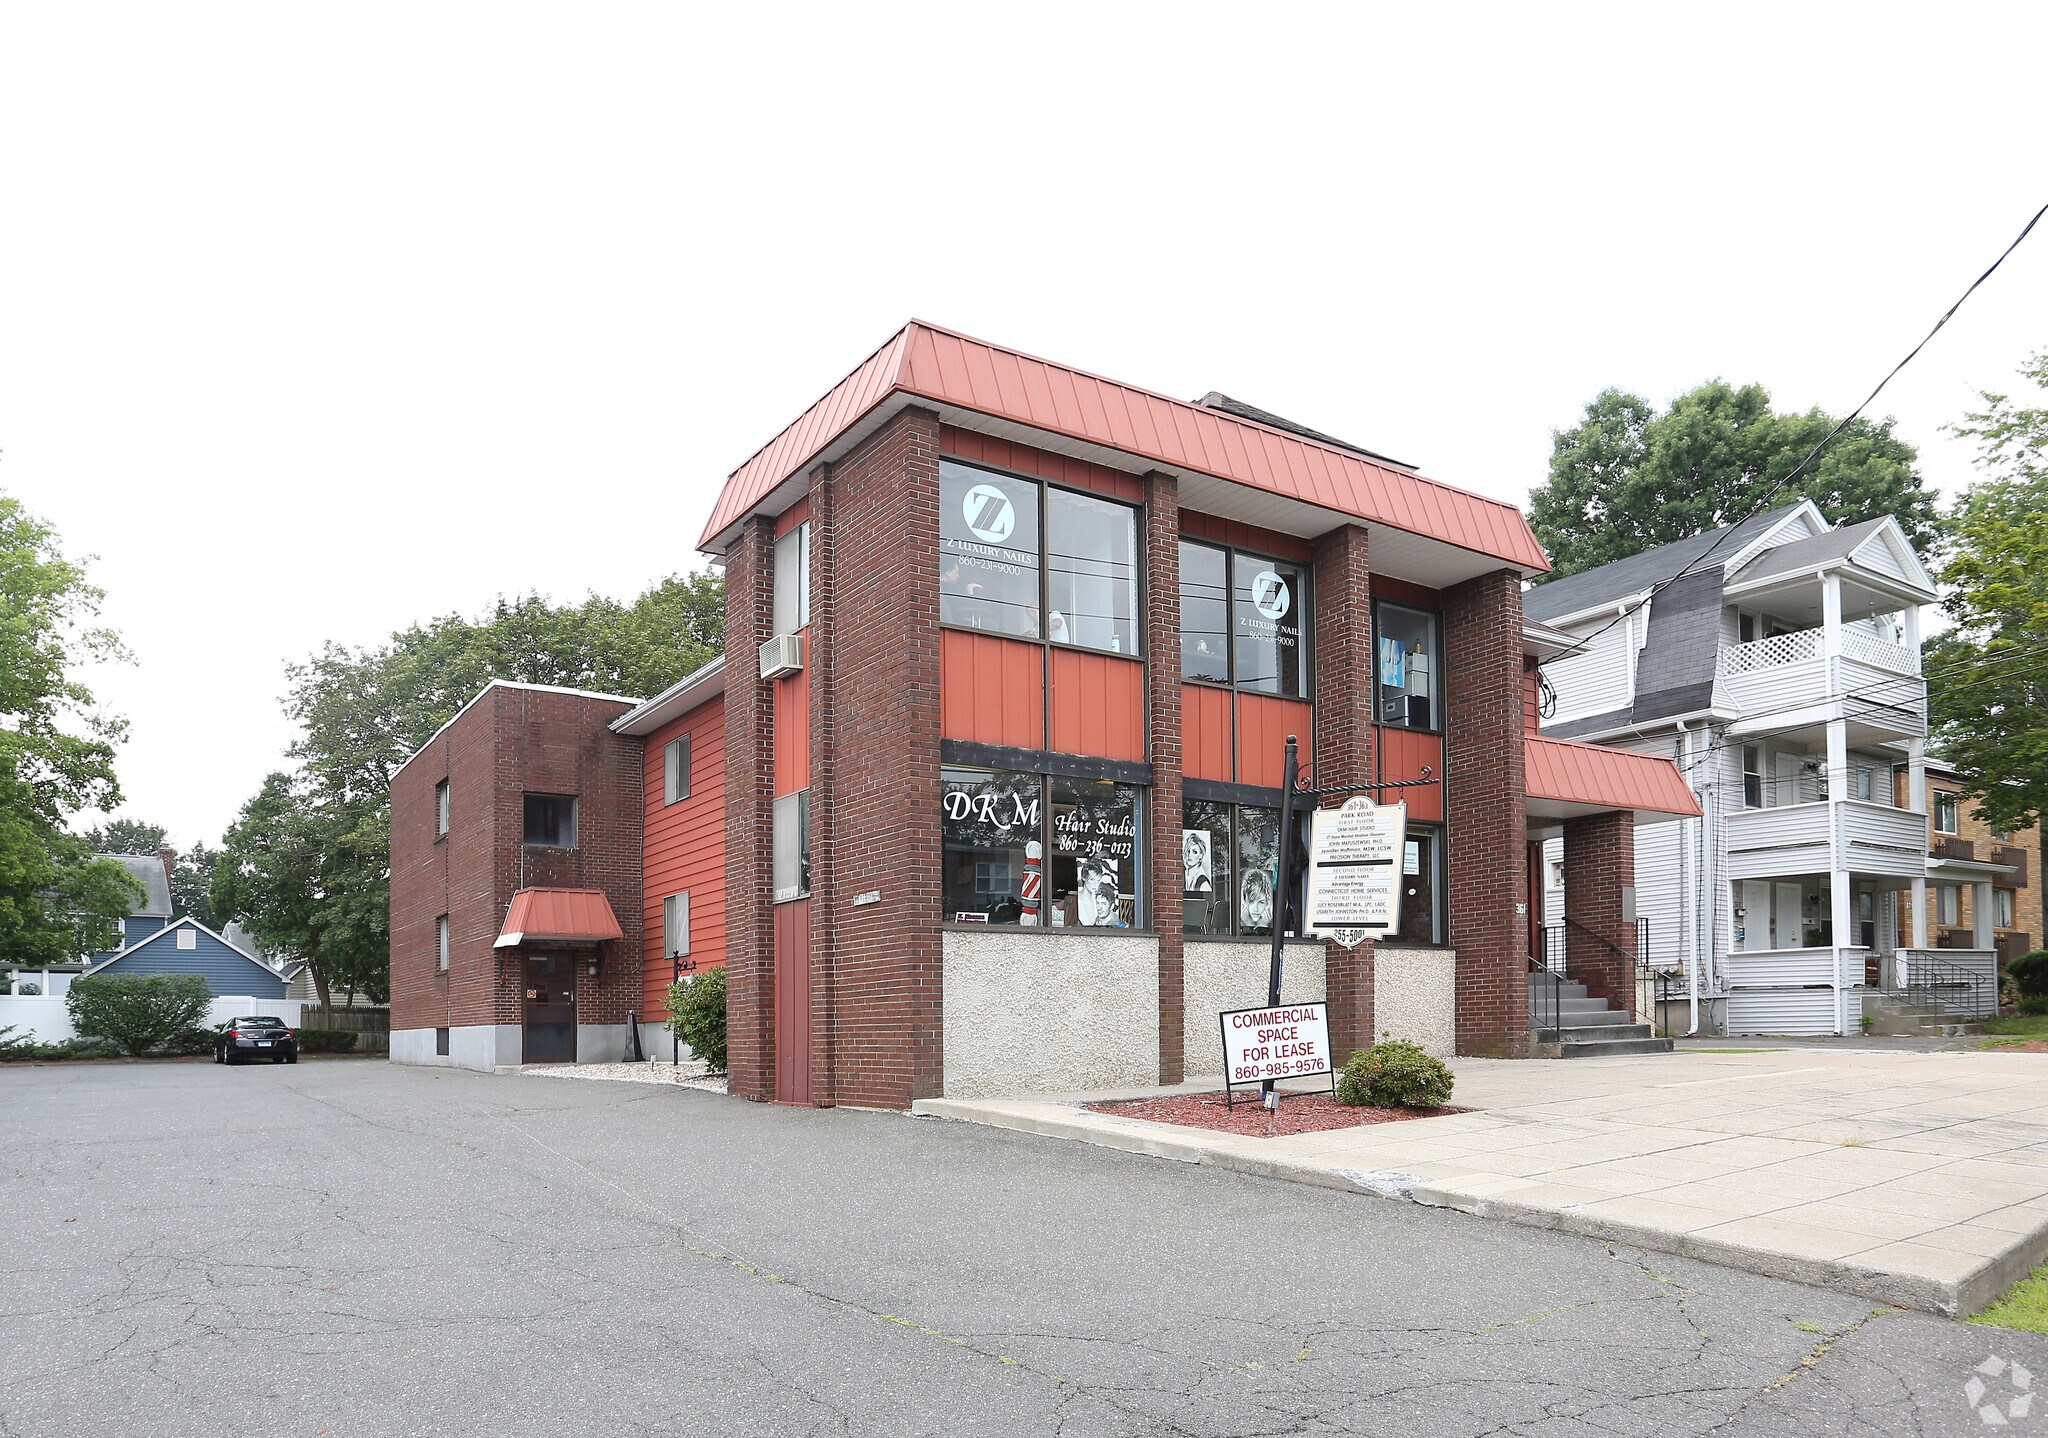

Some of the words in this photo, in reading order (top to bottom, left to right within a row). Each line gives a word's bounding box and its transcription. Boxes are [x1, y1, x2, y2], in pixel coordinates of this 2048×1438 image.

[946, 537, 955, 548] Z
[958, 540, 1000, 557] LUXURY
[1003, 550, 1032, 564] NAILS
[958, 554, 1021, 576] 860-231-9000
[1240, 617, 1247, 626] Z
[1249, 618, 1279, 632] LUXURY
[1281, 625, 1303, 636] NAILS
[1055, 810, 1092, 833] Hair
[1096, 815, 1136, 837] Studio
[1059, 834, 1132, 859] 860-236-0123
[1515, 903, 1526, 914] 361
[1333, 928, 1365, 943] 255-5001
[1232, 1008, 1318, 1029] COMMERCIAL
[1257, 1026, 1298, 1043] SPACE
[1243, 1047, 1269, 1062] FOR
[1274, 1042, 1315, 1059] LEASE
[1235, 1058, 1325, 1080] 860-985-9576
